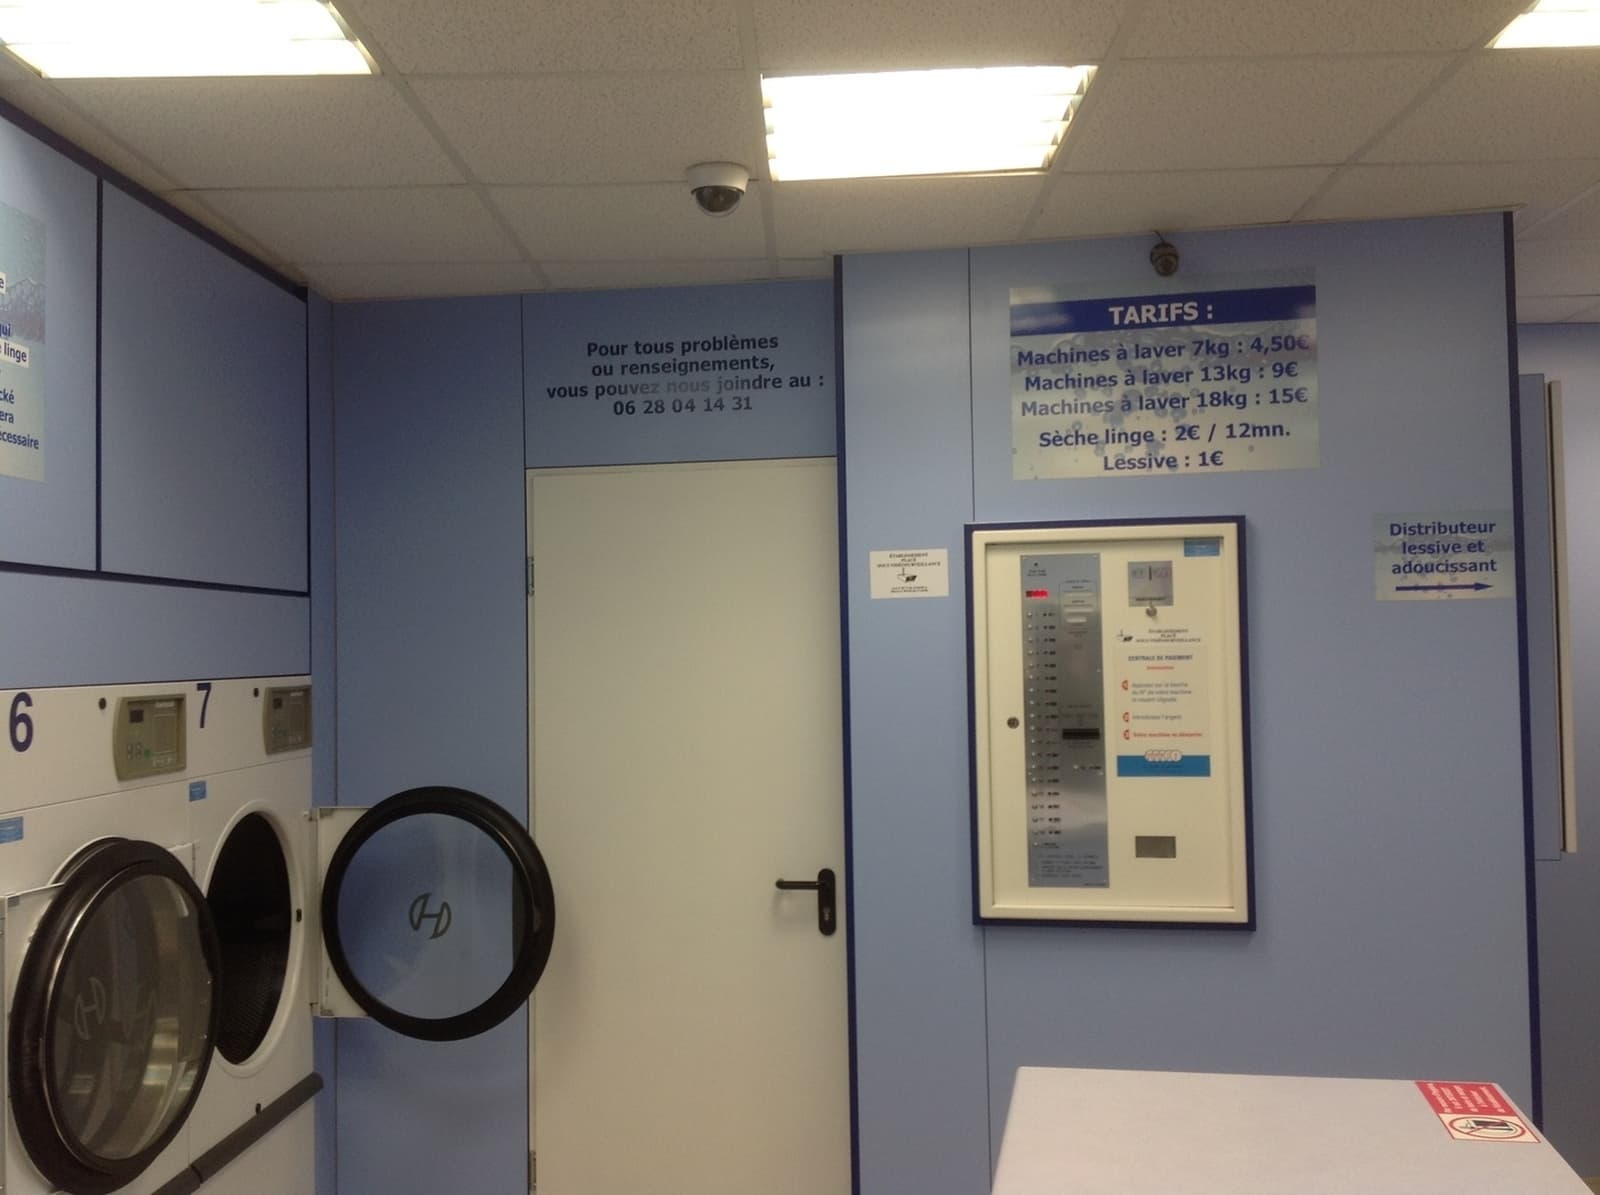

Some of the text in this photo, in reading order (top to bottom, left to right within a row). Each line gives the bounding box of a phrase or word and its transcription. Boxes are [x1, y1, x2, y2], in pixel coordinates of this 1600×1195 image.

[1109, 302, 1198, 325] TARIFS
[4, 342, 27, 362] linge
[587, 335, 778, 356] Pour tous problèmes
[1018, 346, 1110, 366] Machines
[1117, 344, 1127, 360] à
[1135, 343, 1186, 359] laver
[1192, 339, 1229, 358] 7kg
[1250, 335, 1309, 355] 4,50€
[592, 355, 774, 376] ou renseignements,
[1025, 372, 1117, 391] Machines
[1124, 369, 1135, 386] à
[1143, 368, 1193, 384] laver
[1201, 364, 1250, 383] 13kg
[1272, 361, 1298, 378] 9€
[547, 385, 588, 398] vous
[595, 382, 661, 399] pouvez
[667, 379, 709, 394] nous
[716, 374, 782, 394] joindre
[789, 376, 811, 387] au
[613, 396, 752, 415] 06 28 04 14 31
[1021, 399, 1114, 416] Machines
[1121, 394, 1132, 411] à
[1139, 395, 1190, 411] laver
[1197, 390, 1247, 409] 18kg
[1269, 387, 1308, 404] 15€
[1039, 429, 1098, 447] Sèche
[1105, 428, 1155, 446] linge
[1175, 425, 1200, 441] 2€
[1208, 424, 1216, 442] /
[1226, 422, 1291, 439] 12mn.
[1104, 453, 1178, 470] Lessive
[1198, 451, 1224, 467] 1€
[1390, 521, 1496, 536] Distributeur
[1402, 540, 1485, 555] lessive et
[1392, 559, 1497, 574] adoucissant
[196, 682, 212, 728] 7
[9, 691, 33, 752] 6
